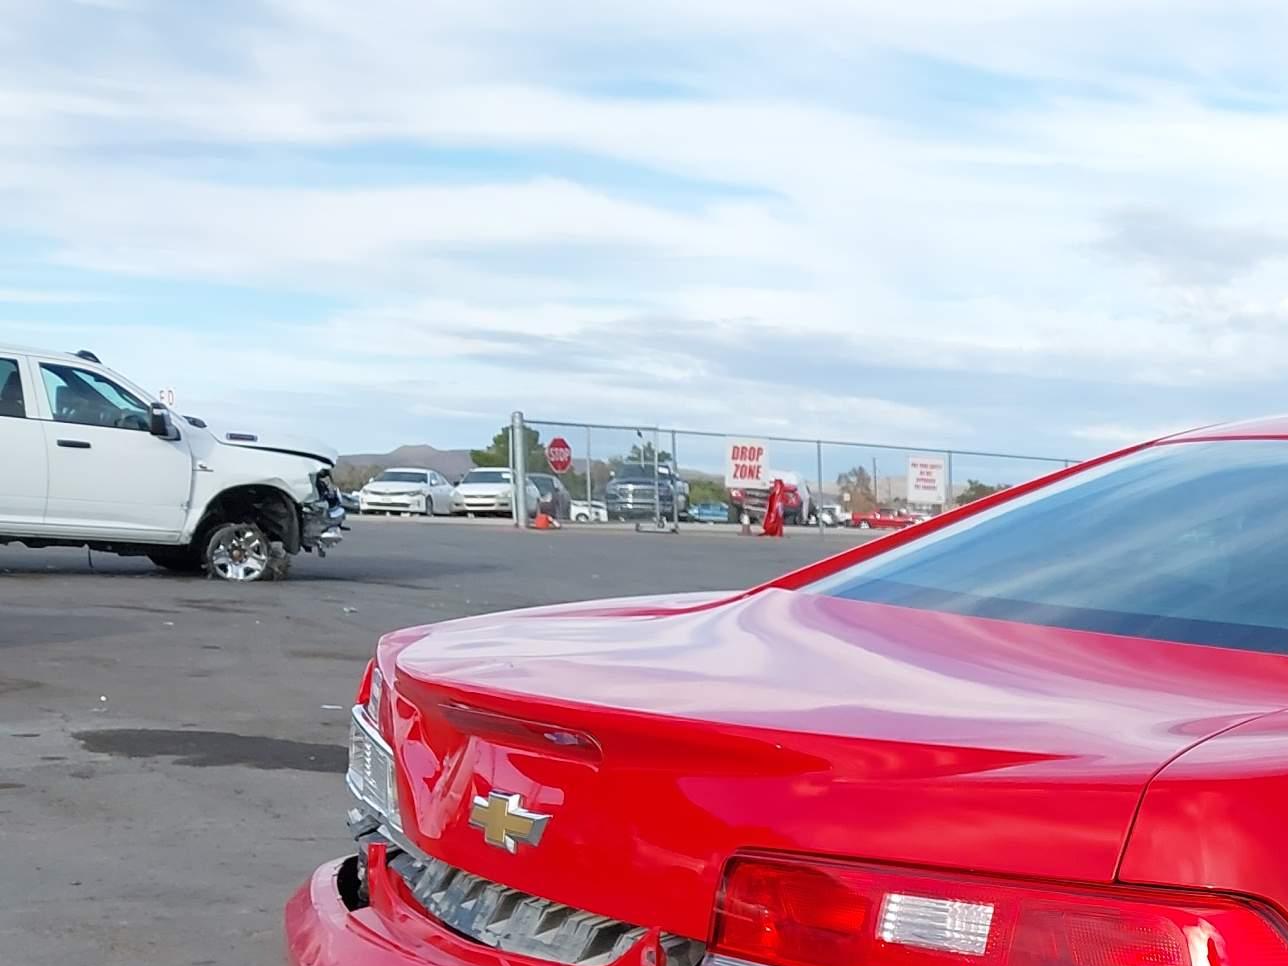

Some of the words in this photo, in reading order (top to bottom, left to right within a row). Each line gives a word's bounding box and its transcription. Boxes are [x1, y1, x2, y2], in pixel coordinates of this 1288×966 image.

[549, 447, 570, 462] STOP
[731, 445, 764, 462] DROP
[732, 463, 762, 481] ZONE
